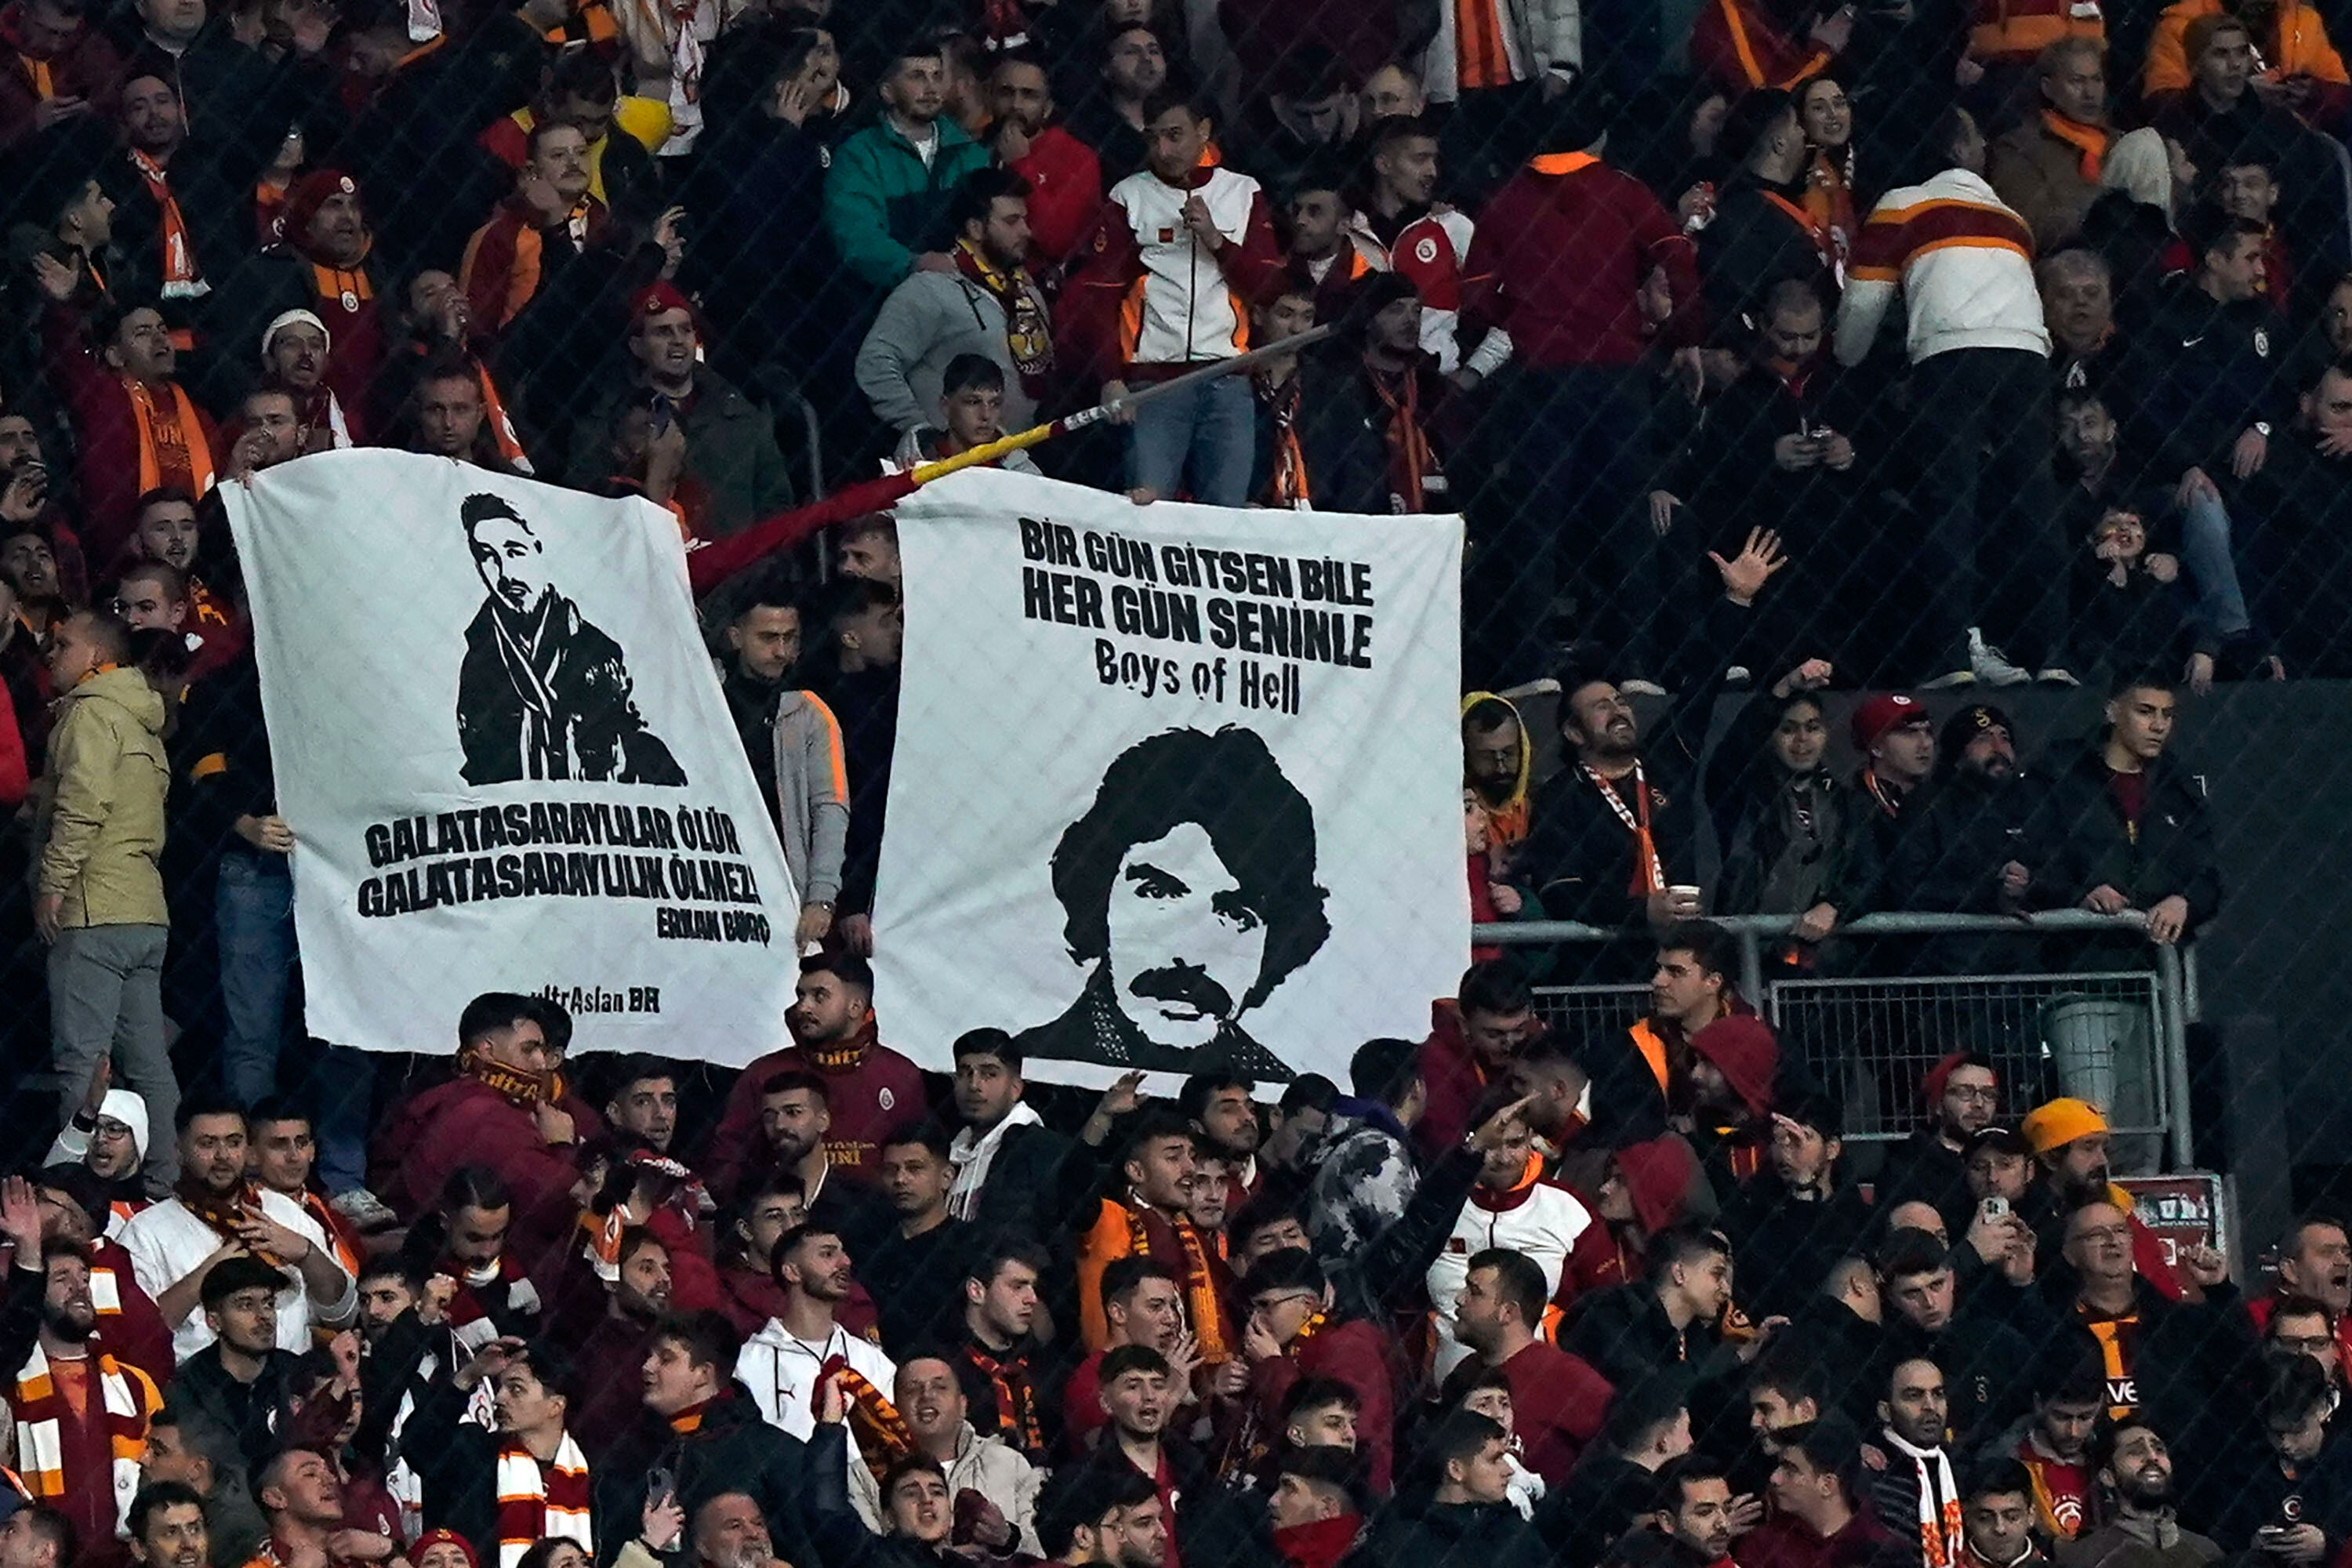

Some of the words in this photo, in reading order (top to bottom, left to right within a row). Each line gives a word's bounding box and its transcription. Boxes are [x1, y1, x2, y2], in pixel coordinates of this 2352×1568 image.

[1018, 517, 1081, 568] BİR
[1083, 531, 1158, 583] GÜN
[1161, 542, 1294, 599] GİTSEN
[1298, 555, 1374, 607] BİLE
[1023, 567, 1106, 629] HER
[1112, 583, 1202, 644] GÜN
[1207, 598, 1374, 669] SENİNLE
[1095, 638, 1181, 699] Boys
[1192, 658, 1227, 702] of
[1240, 660, 1300, 716] Hell
[364, 802, 677, 869] GALATASARAYLILAR
[677, 804, 742, 855] ÖLÜR
[358, 851, 670, 918] GALATASARAYLILIK
[669, 852, 764, 906] ÖLMEZ!
[530, 985, 624, 1014] ltrAslan
